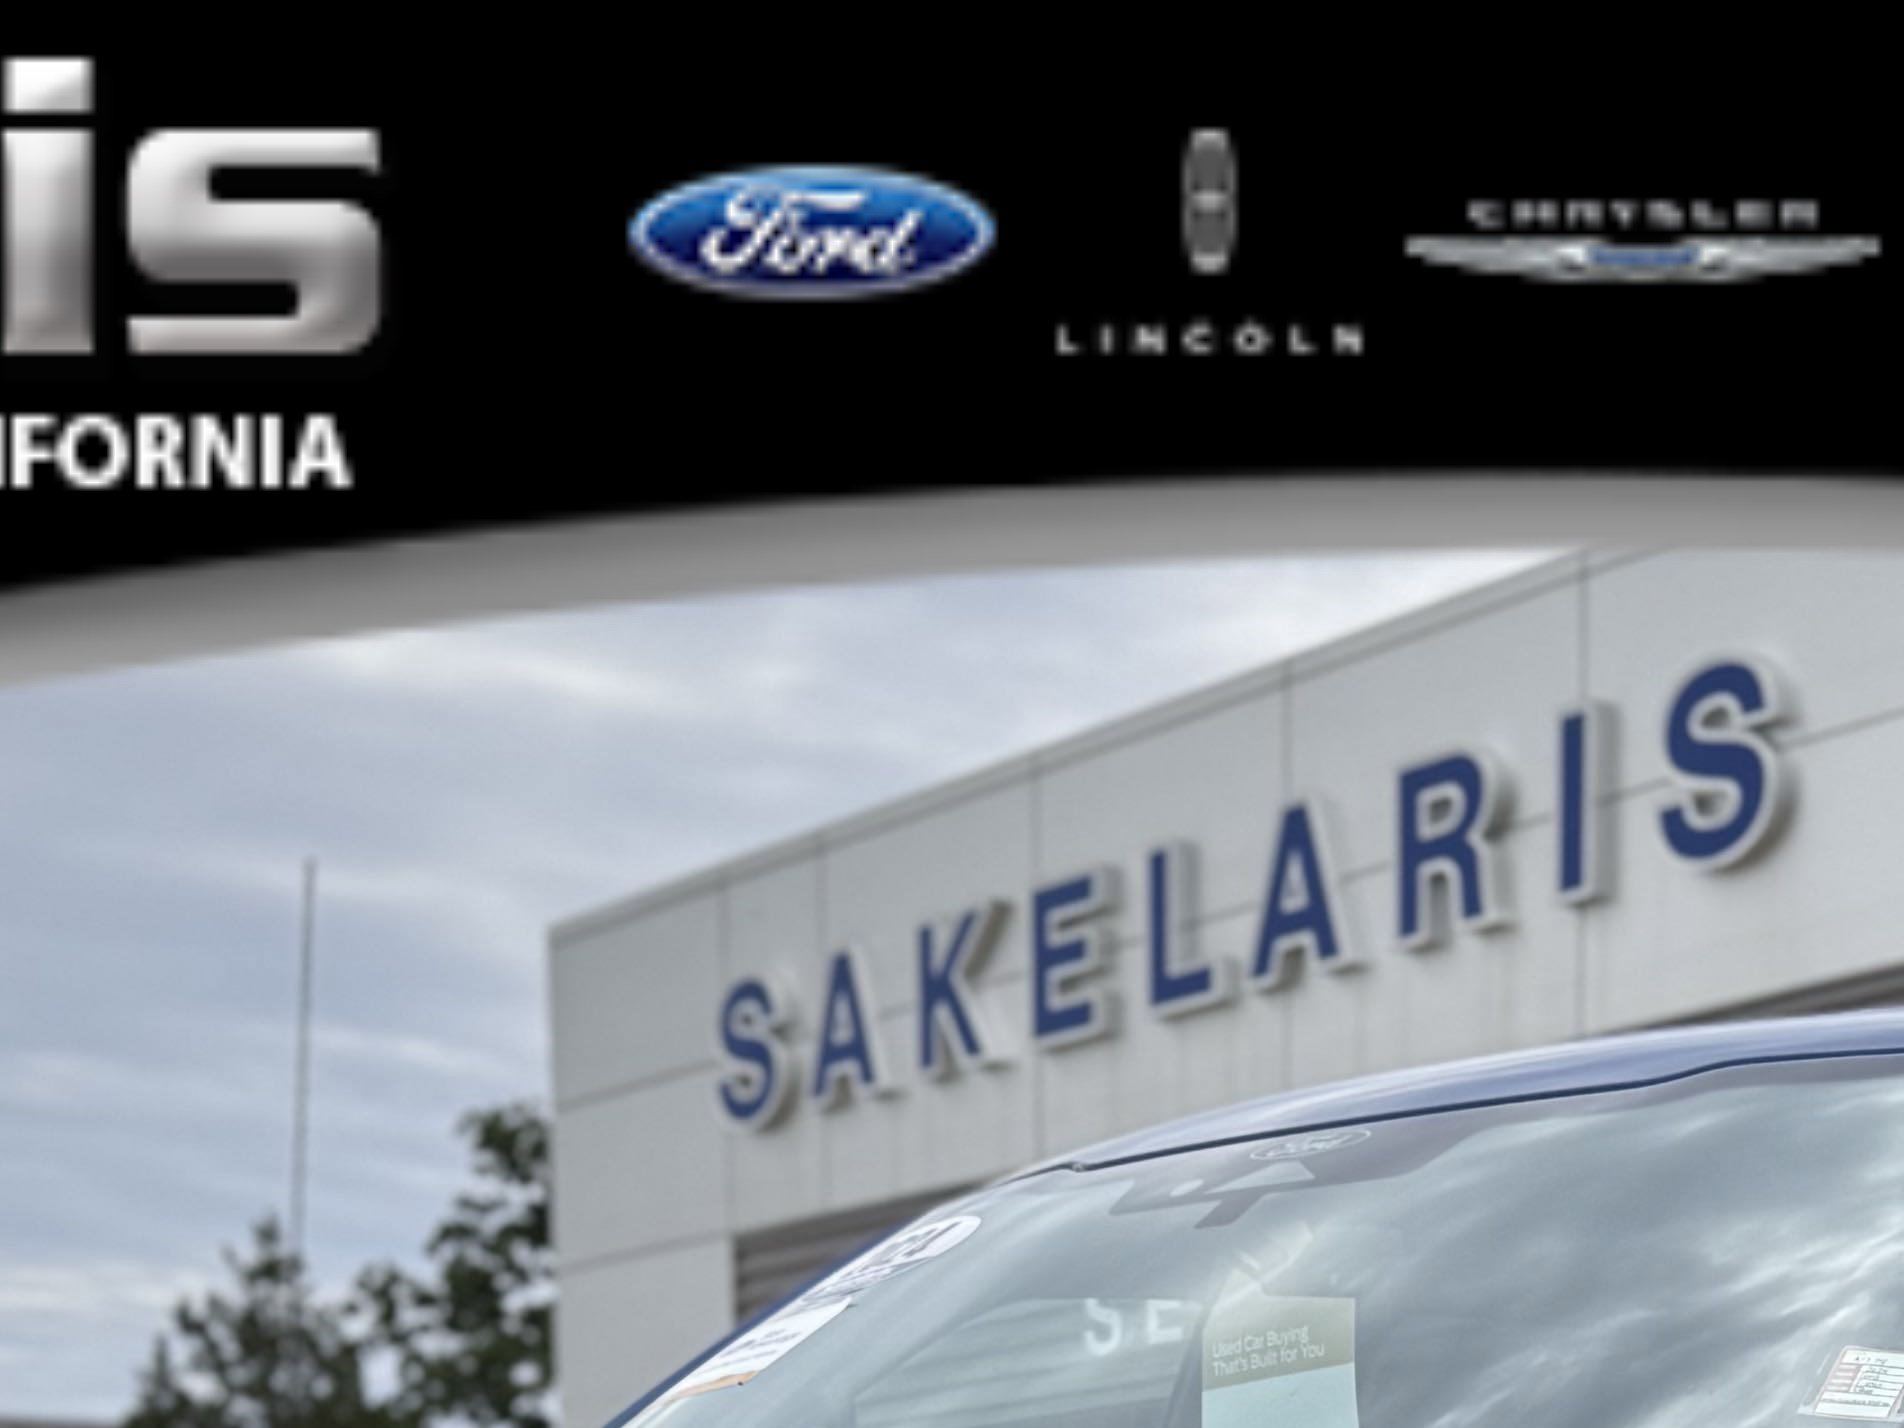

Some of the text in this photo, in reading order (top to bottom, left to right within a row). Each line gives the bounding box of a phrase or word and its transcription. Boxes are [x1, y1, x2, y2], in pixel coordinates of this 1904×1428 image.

[714, 658, 1786, 1130] SAKELARIS
[1211, 1324, 1310, 1359] Used Car Buying
[1280, 1346, 1297, 1364] for
